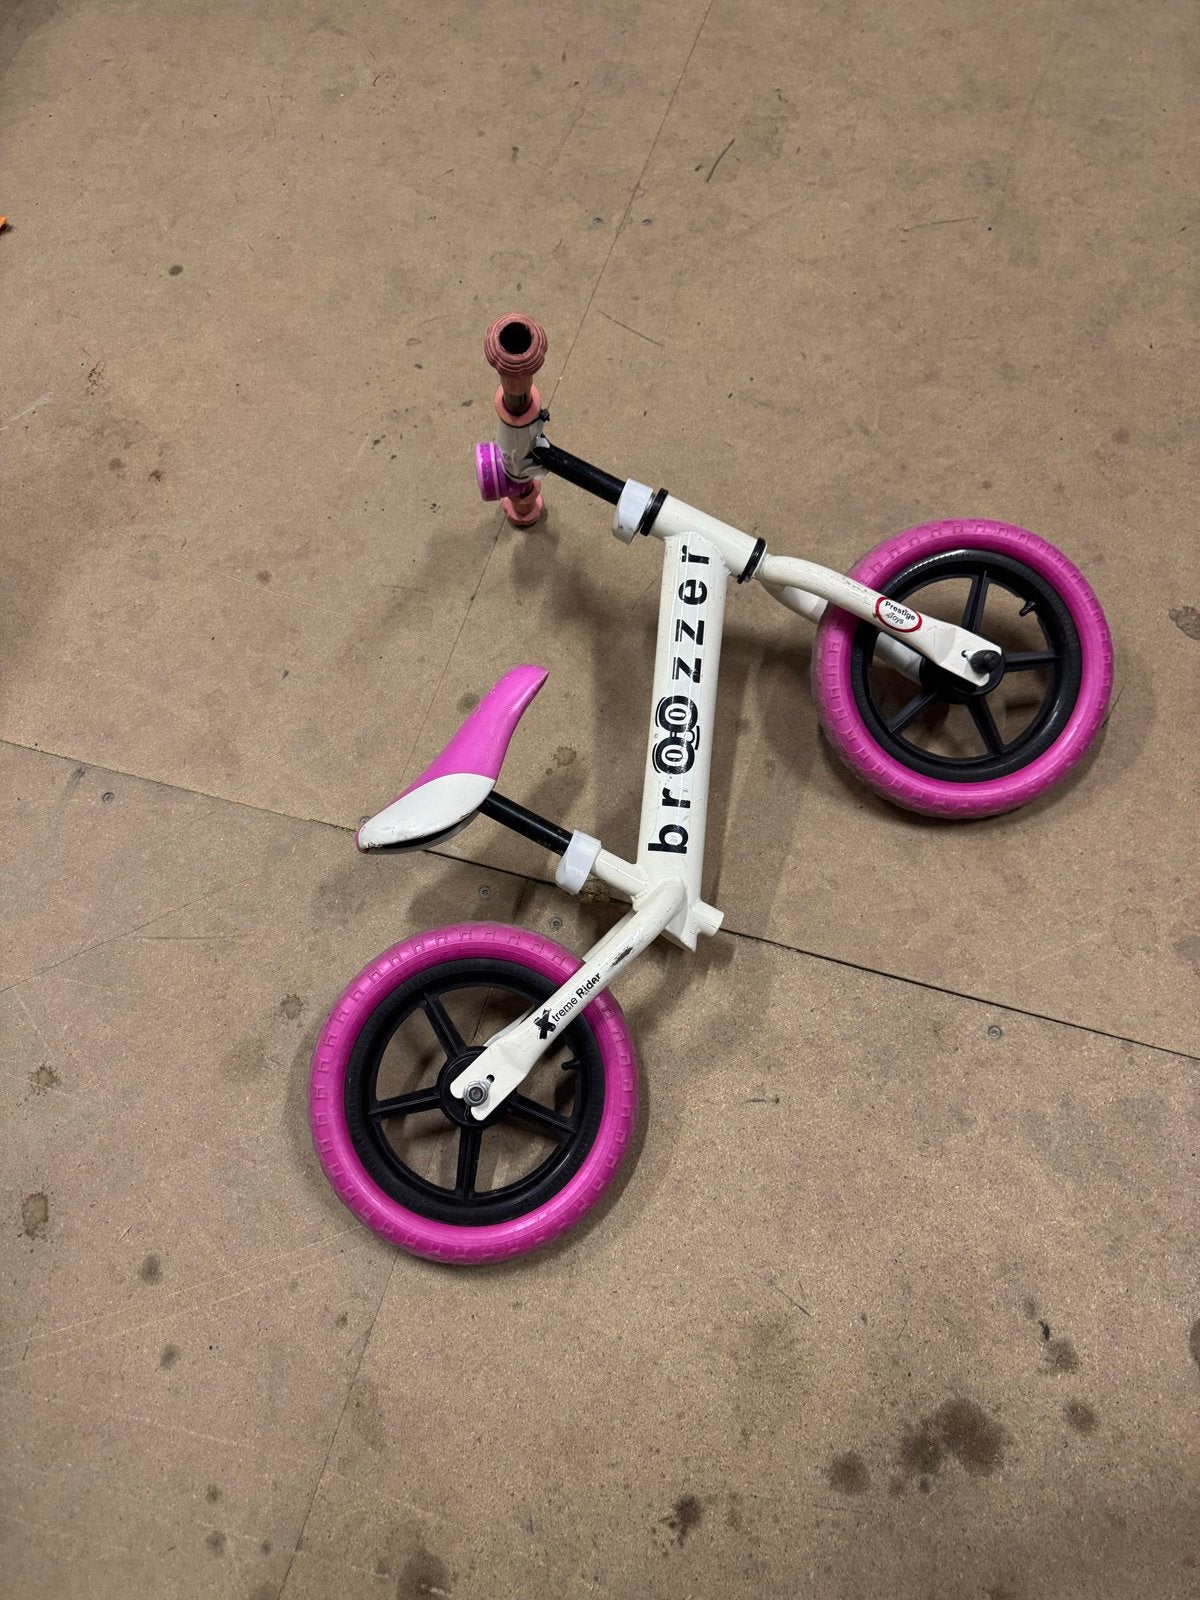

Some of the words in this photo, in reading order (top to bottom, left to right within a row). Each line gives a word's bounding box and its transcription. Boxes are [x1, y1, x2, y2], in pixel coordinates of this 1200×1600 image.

[884, 600, 916, 621] Prestige
[889, 612, 905, 625] Toys
[575, 972, 602, 1000] Rider
